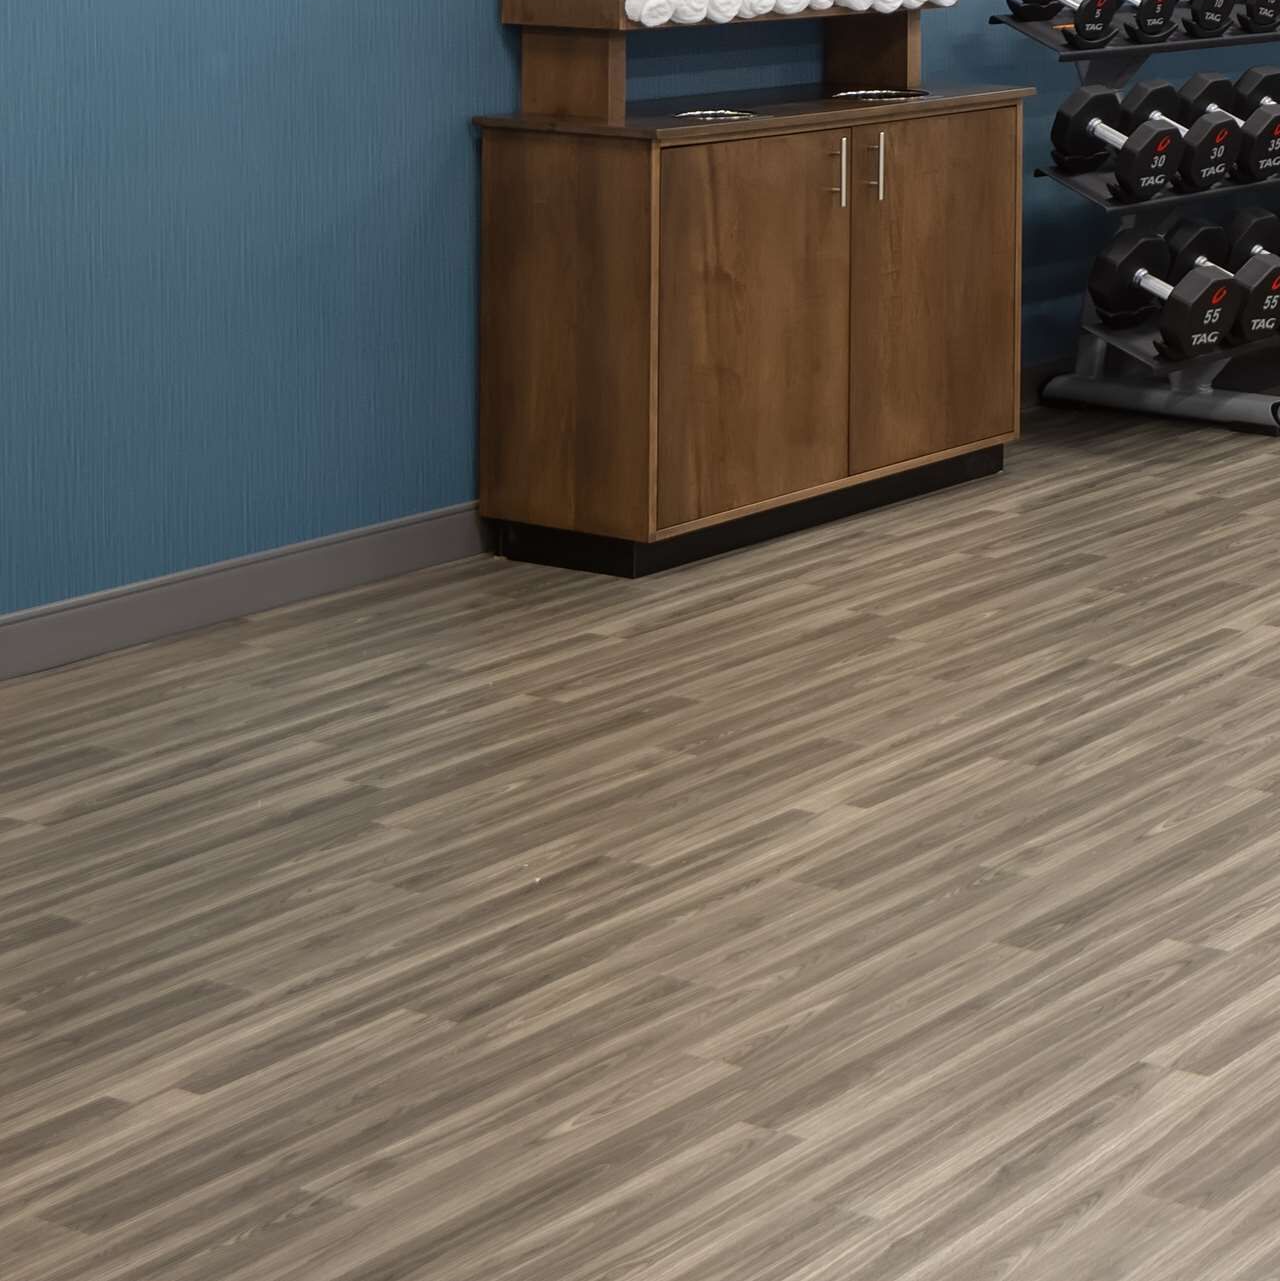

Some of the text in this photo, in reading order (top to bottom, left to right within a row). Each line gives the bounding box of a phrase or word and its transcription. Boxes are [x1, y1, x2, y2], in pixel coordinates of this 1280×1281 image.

[1204, 11, 1222, 23] TAG
[1258, 7, 1274, 18] TAG
[1085, 22, 1104, 31] TAG
[1146, 17, 1164, 26] TAG
[1210, 145, 1225, 160] 30
[1150, 154, 1166, 169] 30
[1200, 162, 1225, 178] TAG
[1140, 174, 1165, 187] TAG
[1263, 294, 1280, 310] 55
[1203, 307, 1222, 325] 55
[1251, 317, 1276, 331] TAG
[1191, 331, 1219, 346] TAG
